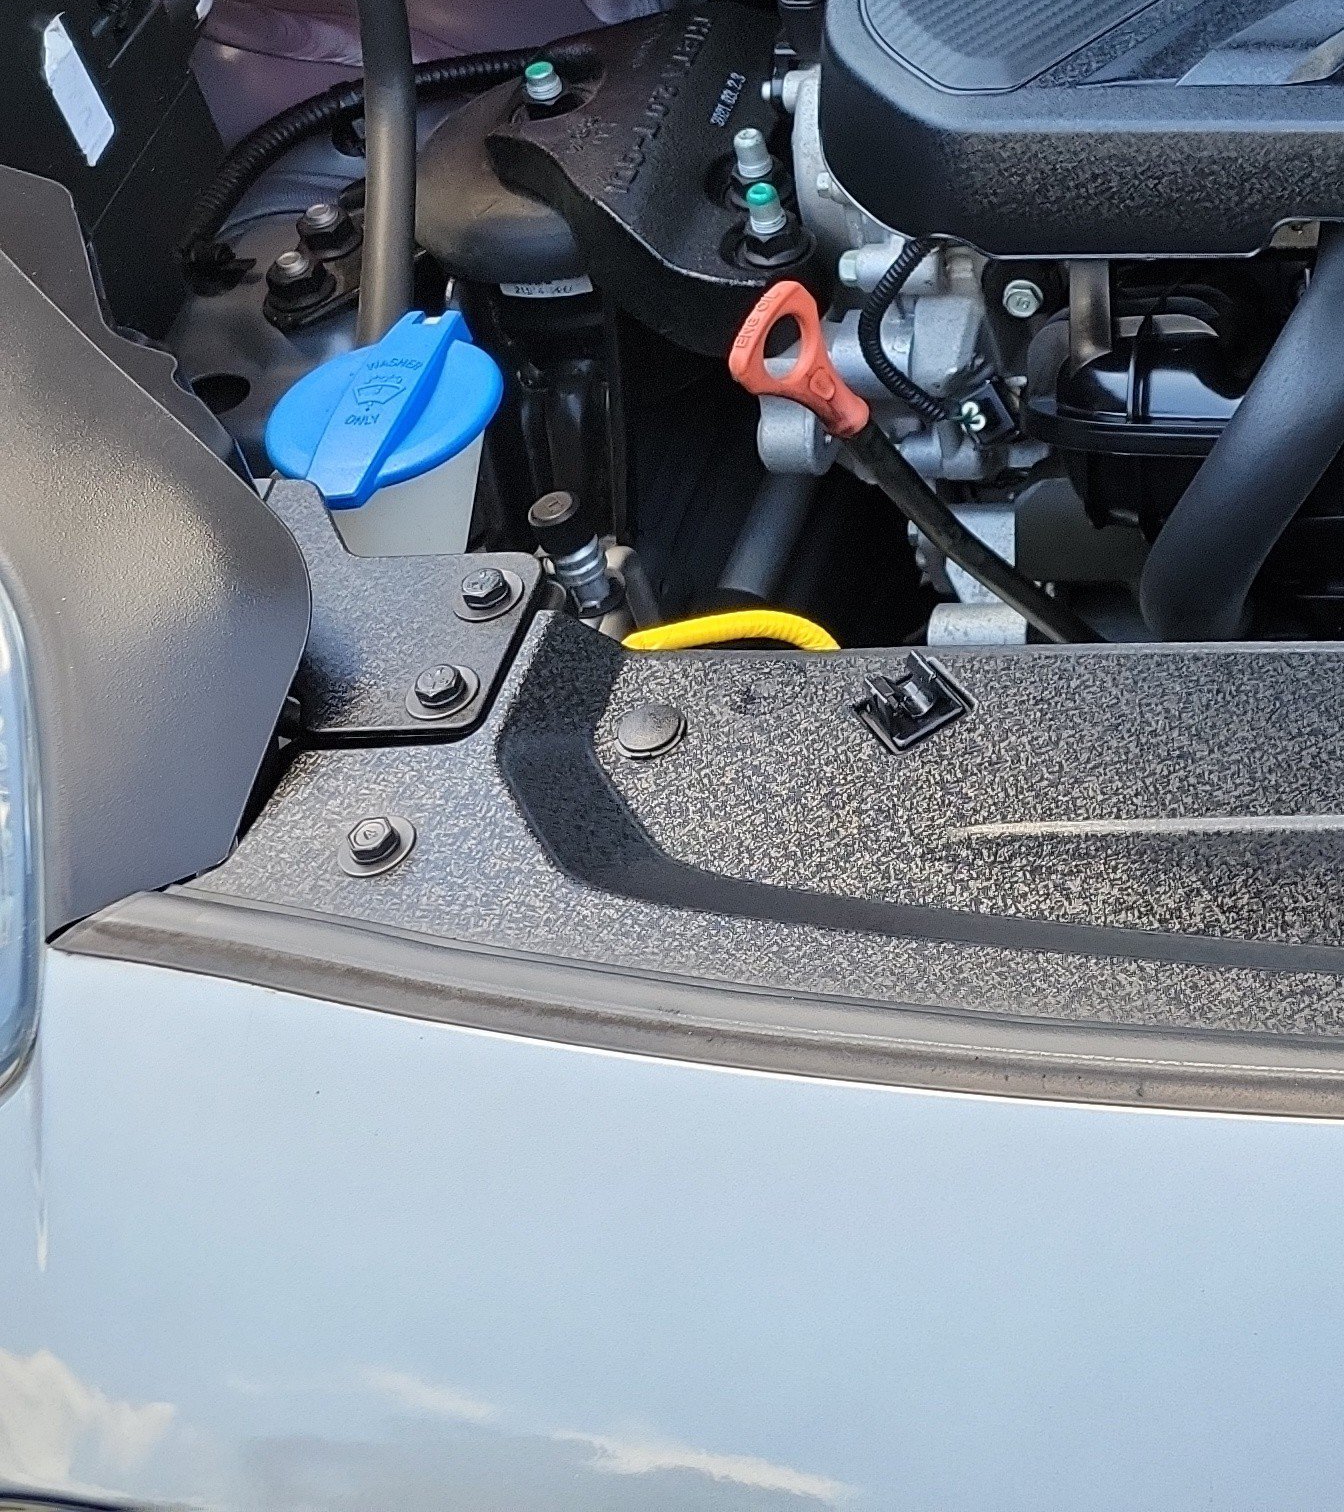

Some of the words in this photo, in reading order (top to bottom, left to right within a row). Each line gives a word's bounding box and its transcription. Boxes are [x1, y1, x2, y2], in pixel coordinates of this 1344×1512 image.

[735, 318, 760, 348] ENG
[757, 292, 780, 312] OIL
[367, 358, 423, 370] WASHER
[344, 414, 380, 426] ONLY
